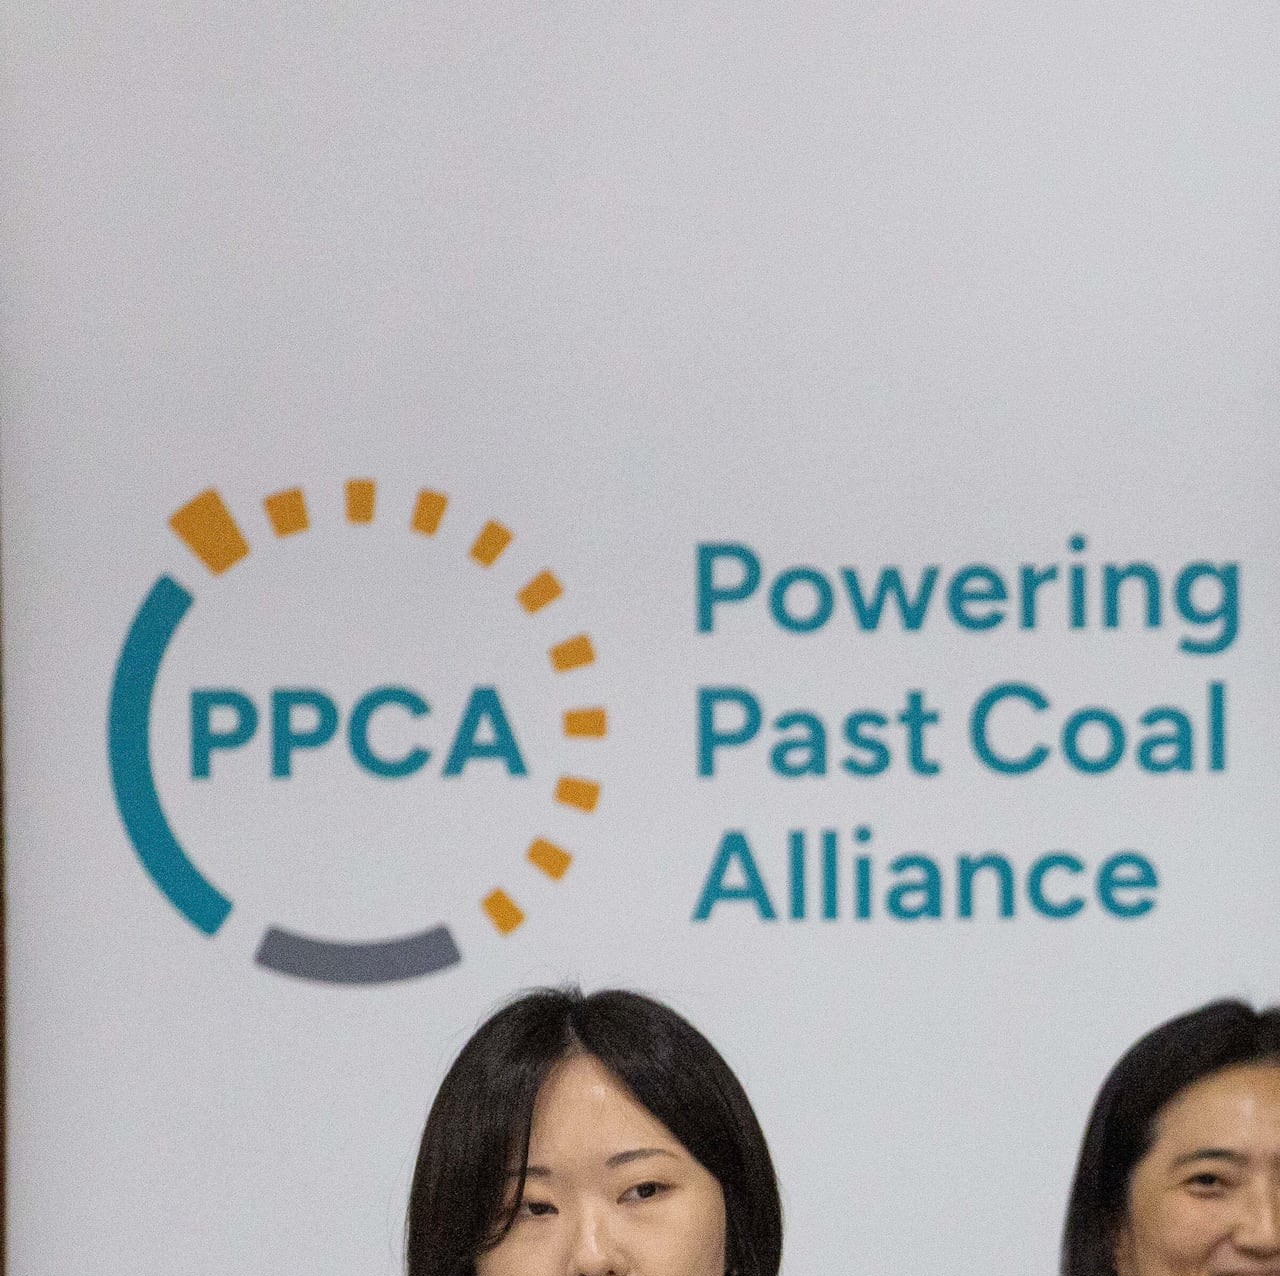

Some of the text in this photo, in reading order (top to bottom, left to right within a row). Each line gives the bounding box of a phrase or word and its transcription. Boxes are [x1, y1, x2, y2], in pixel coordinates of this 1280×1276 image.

[695, 534, 1241, 657] Powering
[189, 686, 529, 780] PPCA
[696, 681, 1226, 778] Past Coal
[692, 825, 1159, 921] Alliance
